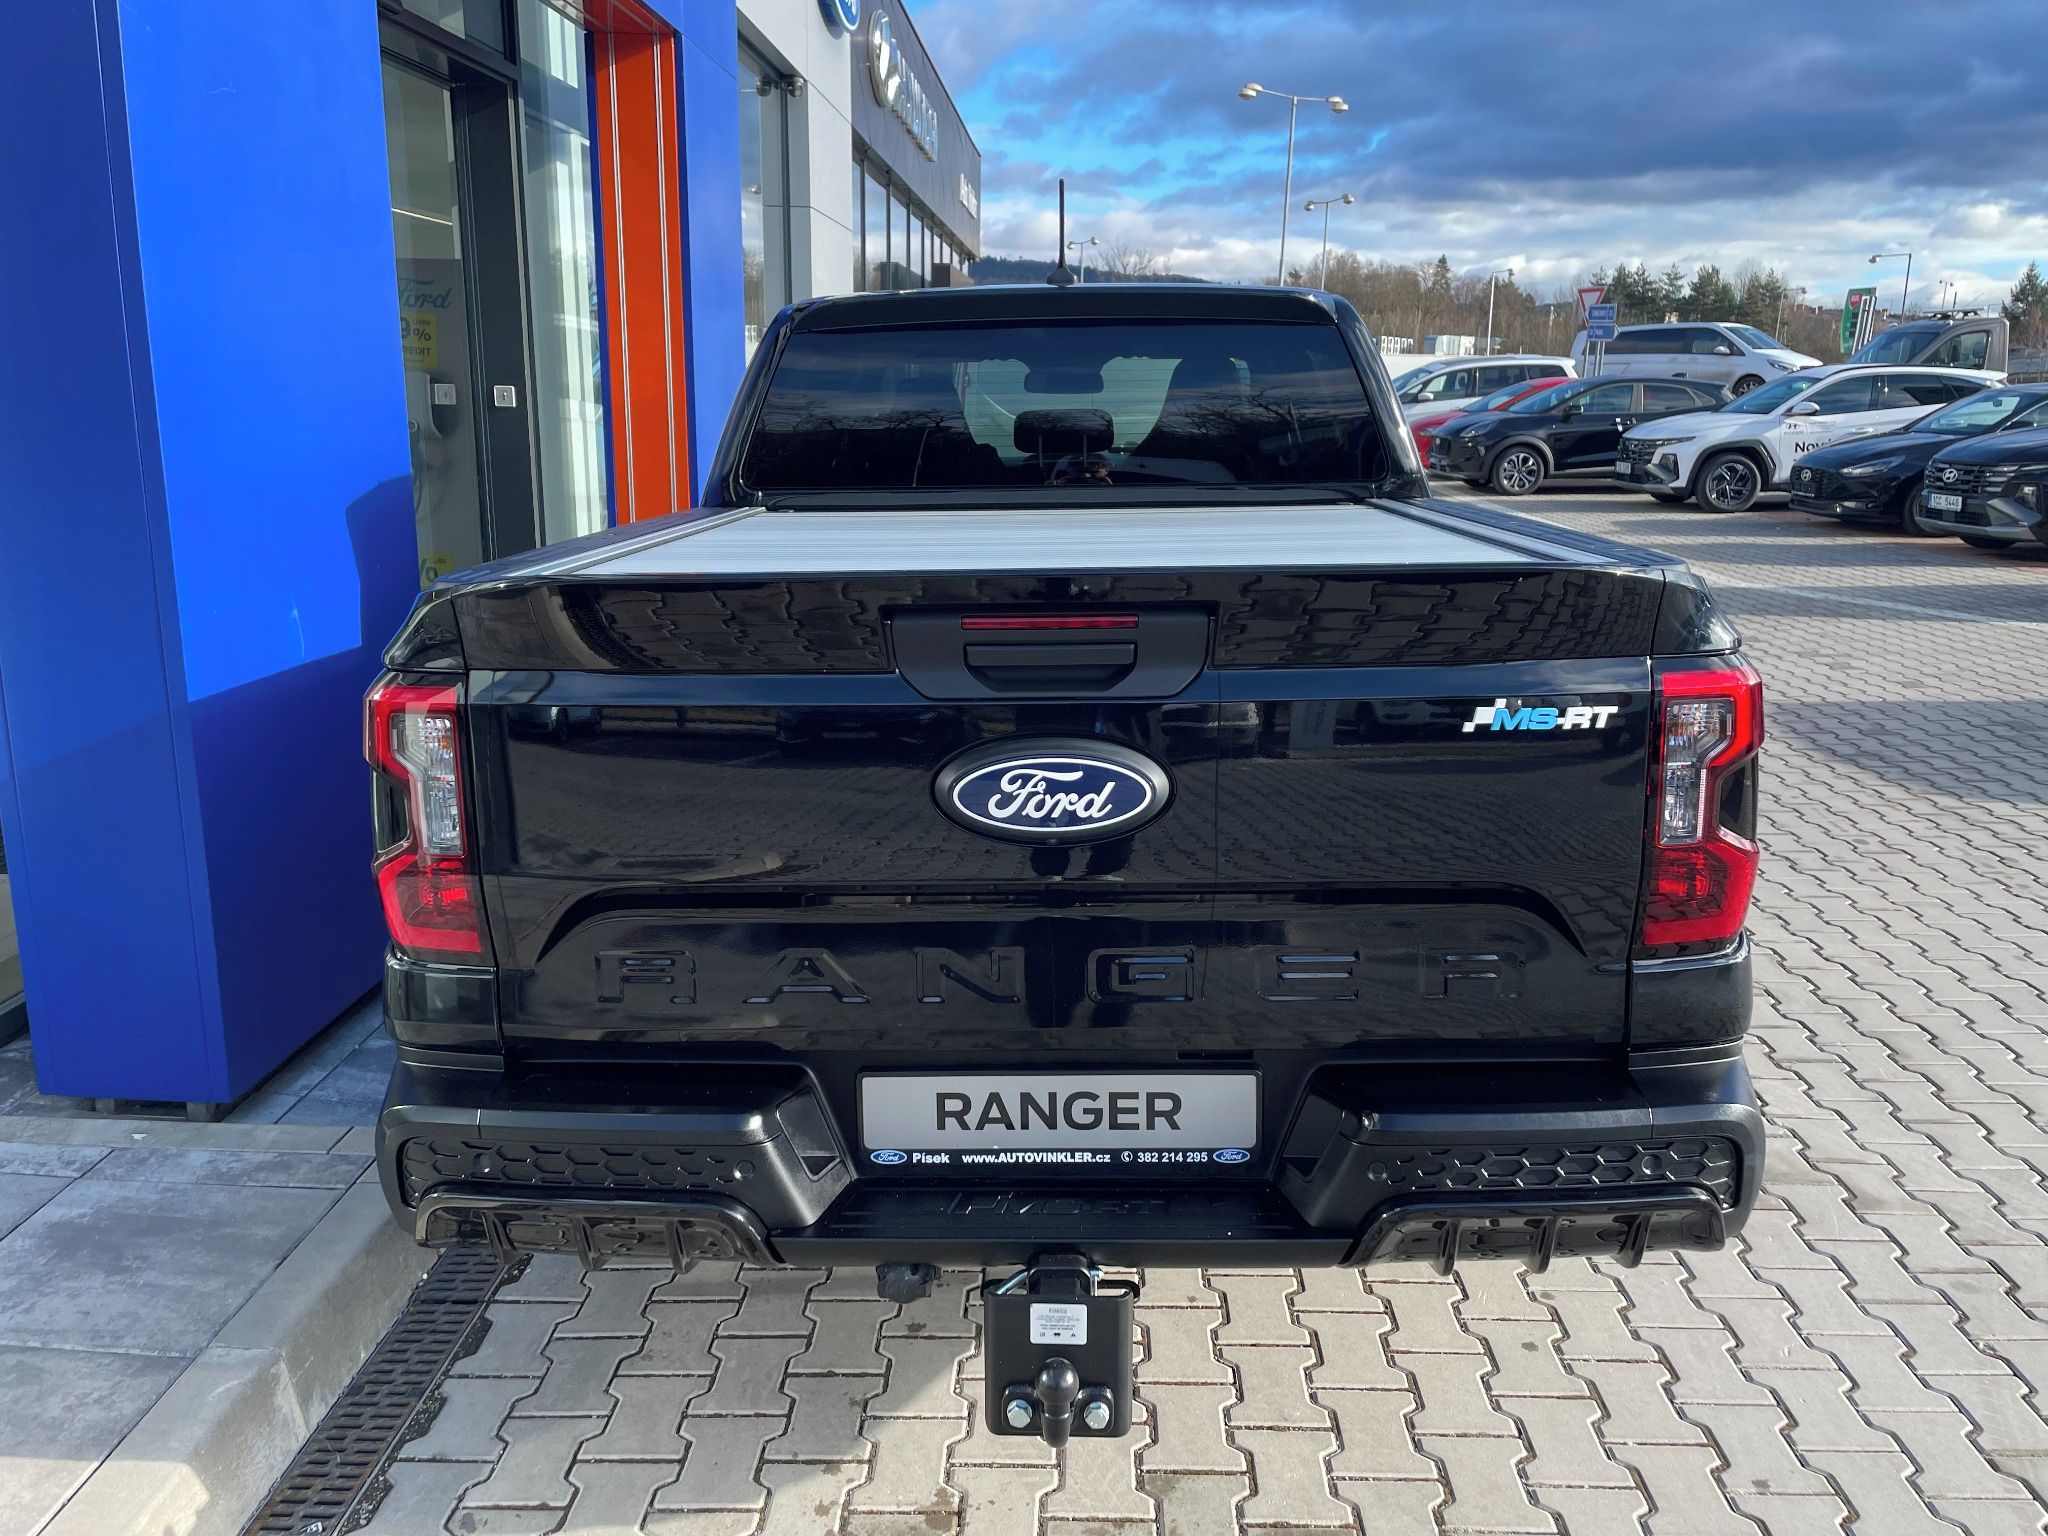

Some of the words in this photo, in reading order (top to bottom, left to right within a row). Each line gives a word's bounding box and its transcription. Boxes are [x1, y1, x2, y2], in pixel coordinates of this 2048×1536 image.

[403, 344, 432, 357] REDIT
[1490, 705, 1619, 731] MS-RT
[987, 768, 1116, 819] Ford
[594, 946, 1527, 1005] RANGER
[935, 1091, 1183, 1131] RANGER
[912, 1152, 950, 1164] Písek
[961, 1151, 1111, 1164] www.AUTOVINKLER.cz
[1137, 1151, 1159, 1163] 382
[1161, 1151, 1184, 1163] 214
[1186, 1151, 1209, 1163] 295
